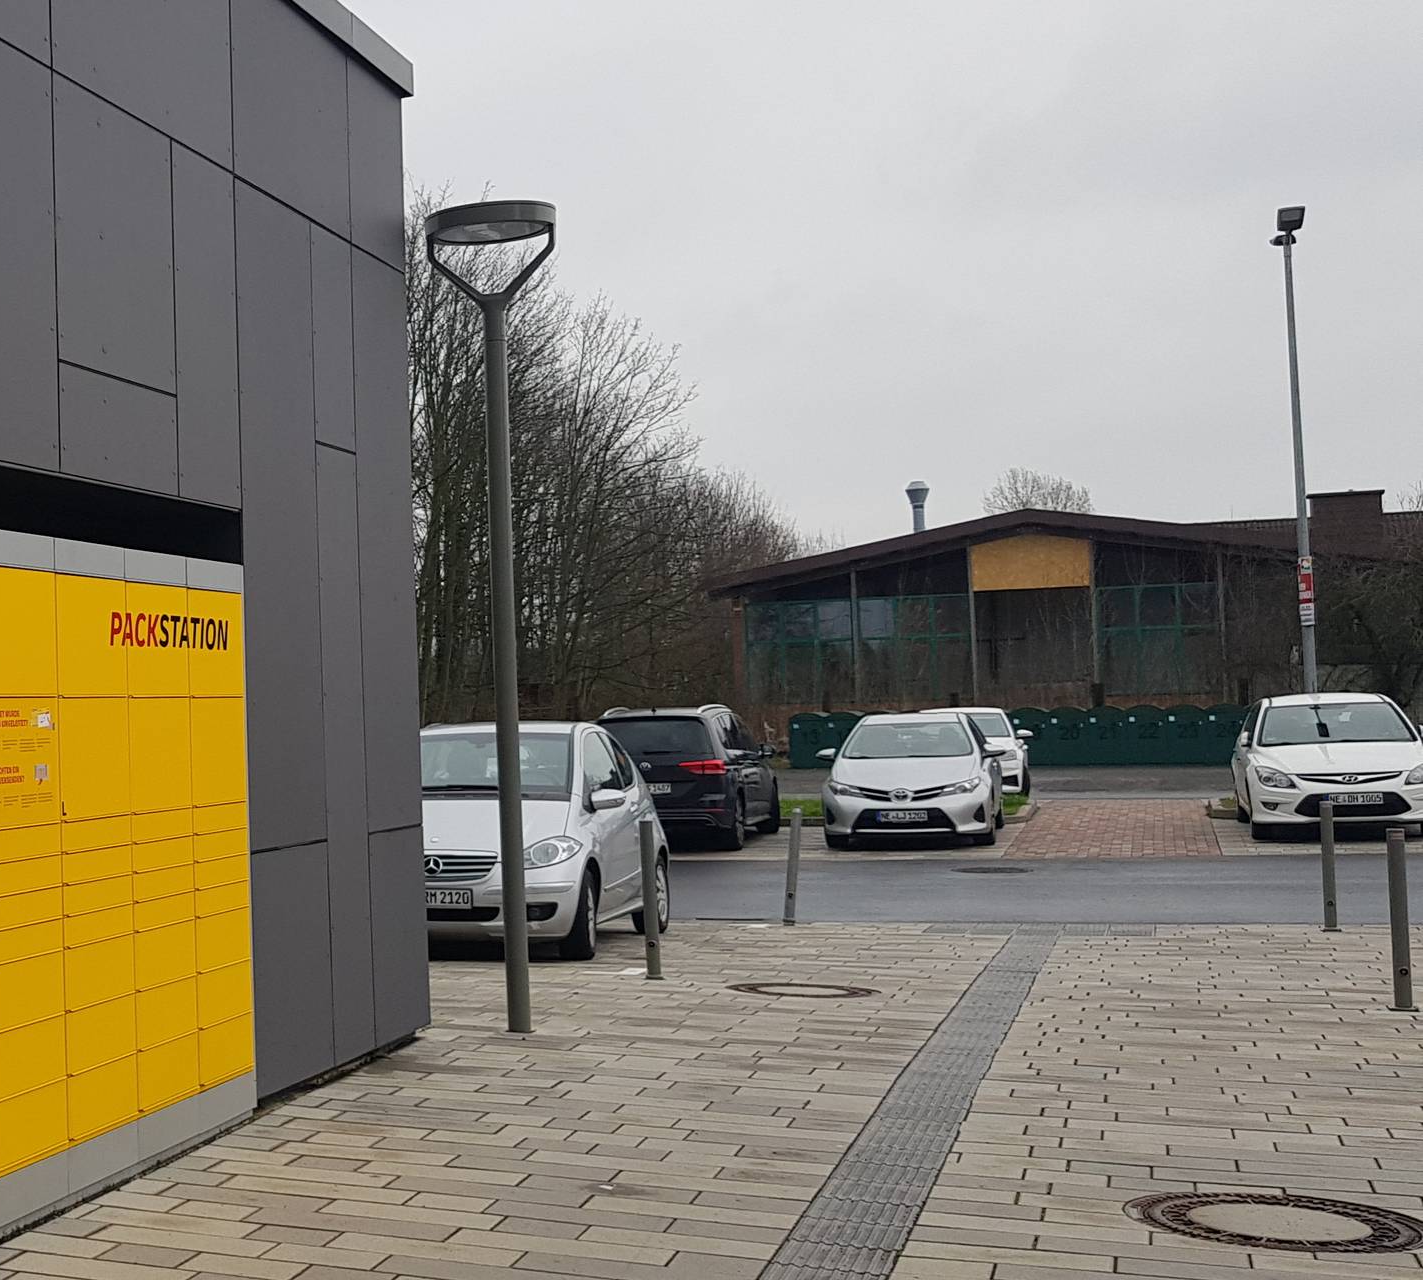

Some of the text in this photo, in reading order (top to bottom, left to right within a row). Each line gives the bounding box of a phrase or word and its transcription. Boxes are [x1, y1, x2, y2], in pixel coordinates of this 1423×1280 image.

[110, 611, 229, 651] PACKSTATION
[61, 801, 67, 816] L
[440, 891, 469, 905] 2120
